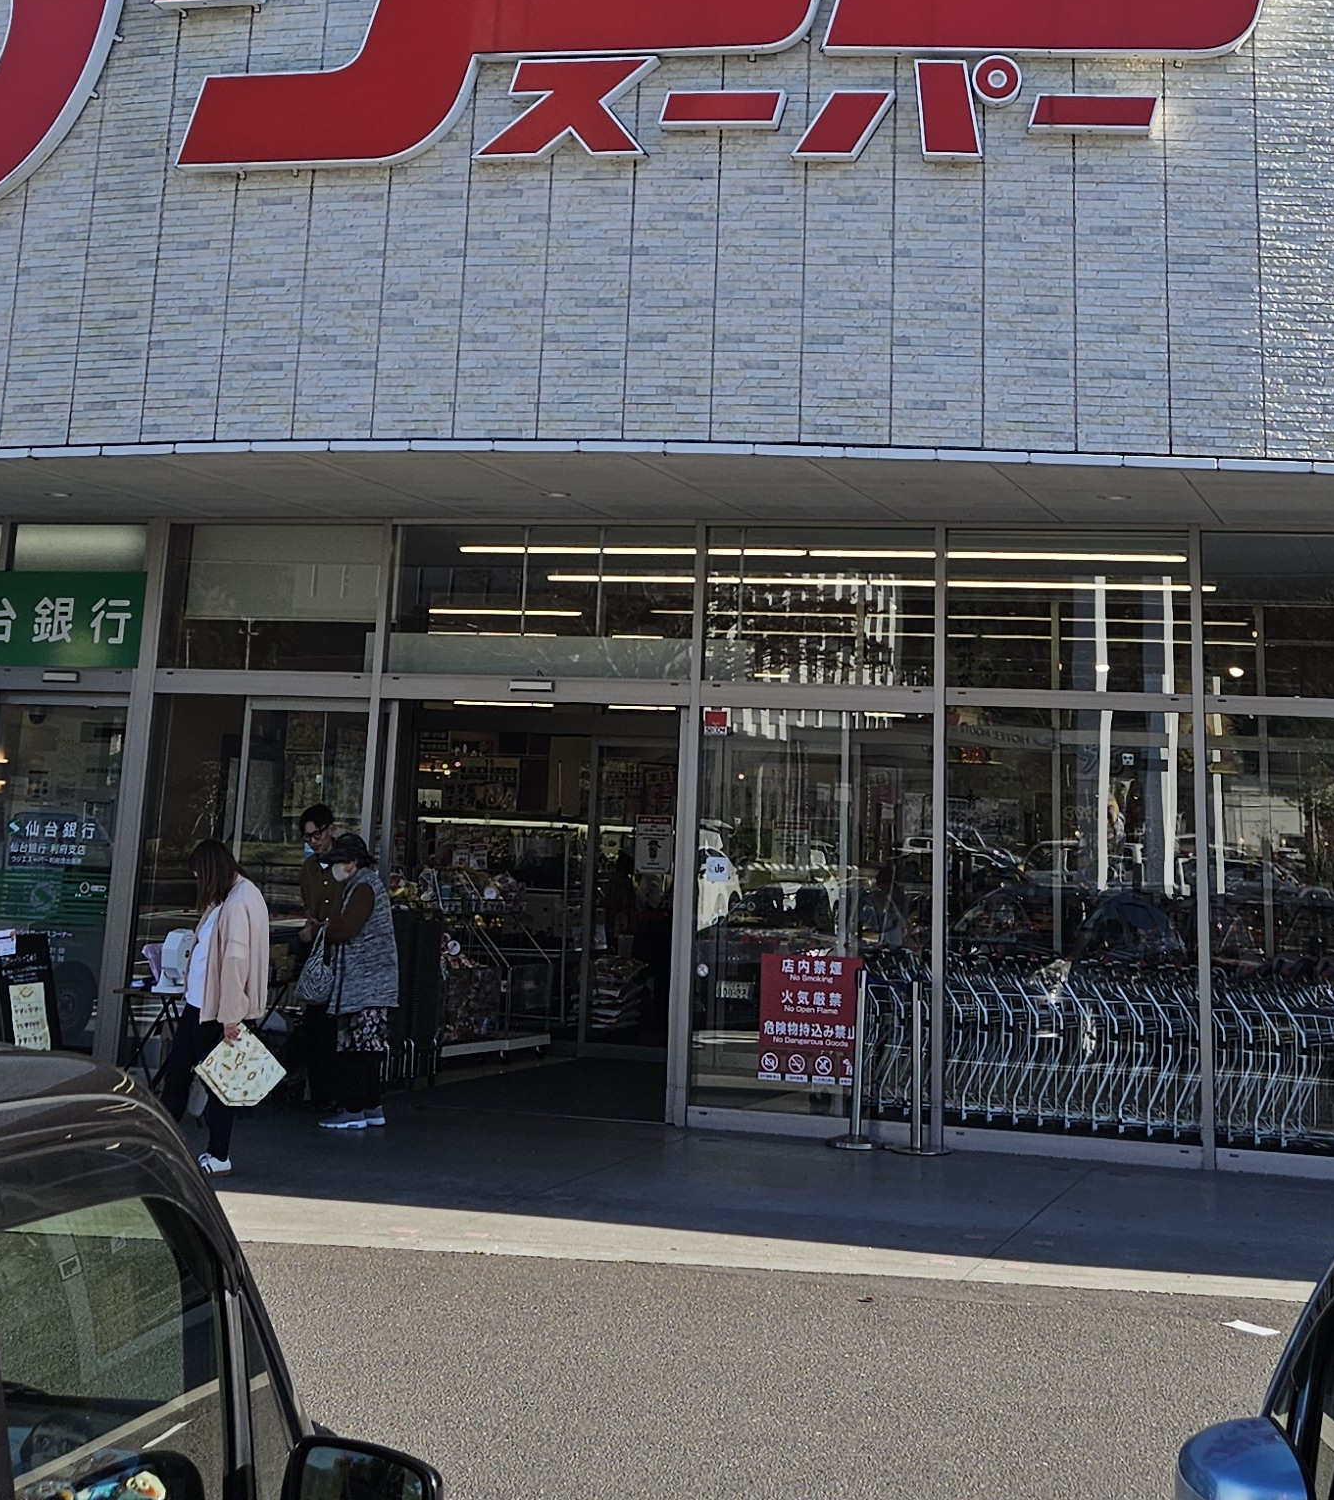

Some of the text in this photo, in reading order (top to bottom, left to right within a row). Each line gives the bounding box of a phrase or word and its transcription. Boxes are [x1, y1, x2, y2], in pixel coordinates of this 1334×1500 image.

[470, 55, 1164, 162] スーパー
[25, 820, 96, 839] 仙台銀行
[782, 959, 842, 975] 店内禁煙
[802, 975, 833, 983] Smoking
[781, 989, 842, 1008] 火気厳禁
[784, 1005, 838, 1015] No Open Flame
[785, 1037, 823, 1046] Dangerous
